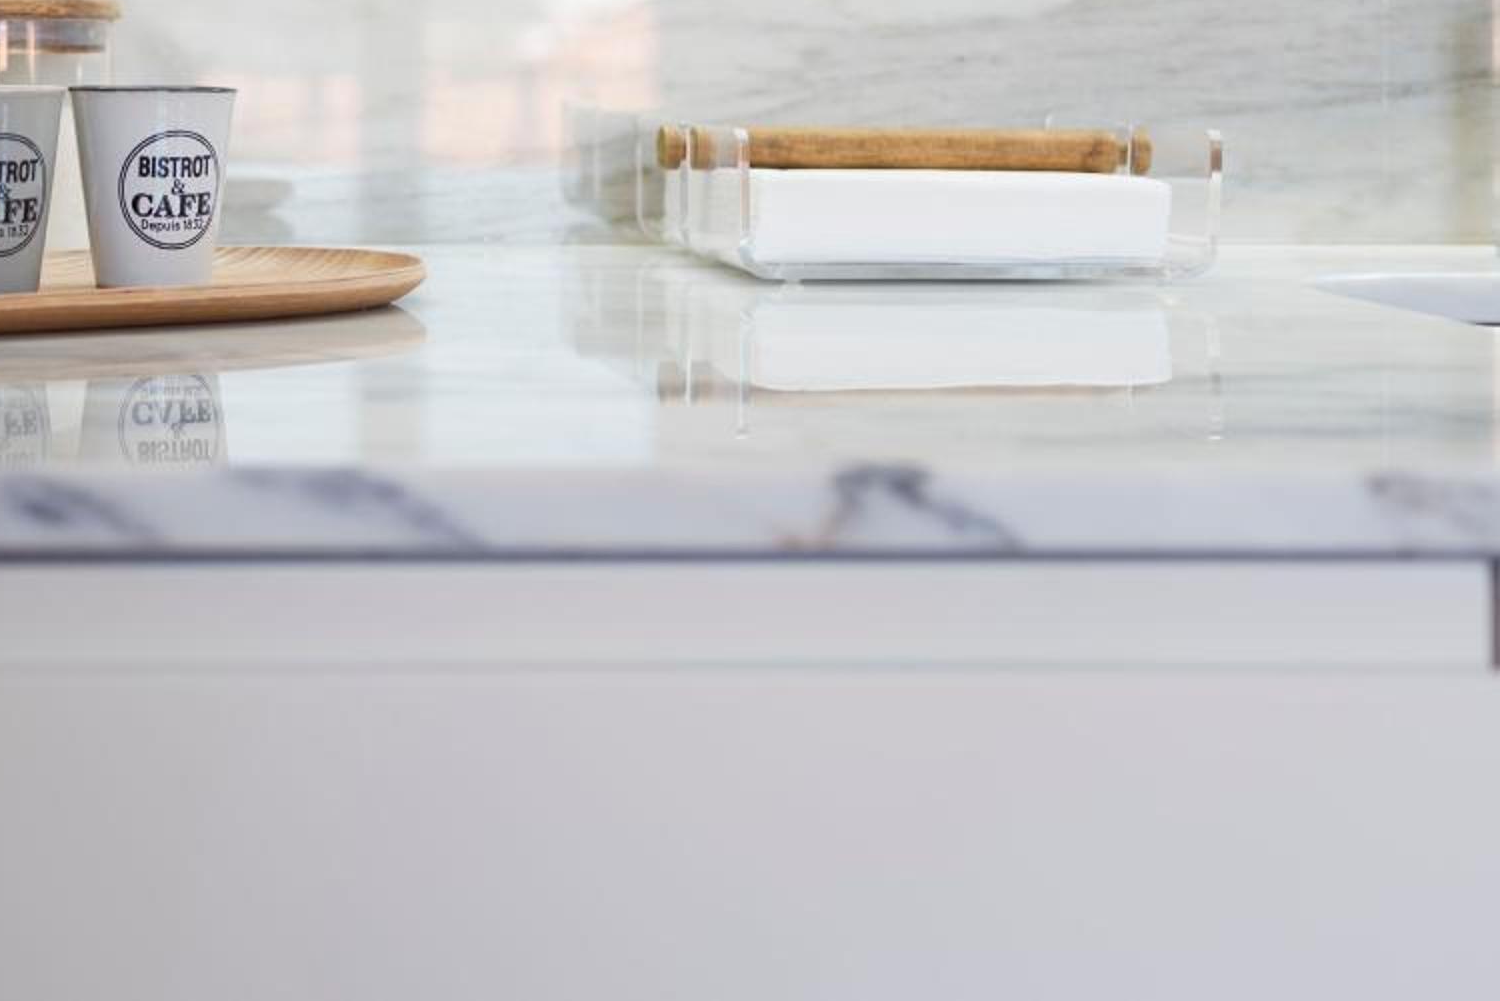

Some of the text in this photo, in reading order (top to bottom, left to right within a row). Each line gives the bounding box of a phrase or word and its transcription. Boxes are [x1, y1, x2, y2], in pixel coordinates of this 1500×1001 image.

[138, 154, 211, 178] BISTROT
[171, 179, 185, 195] &
[131, 191, 211, 218] CAFE
[141, 218, 181, 233] Depuis
